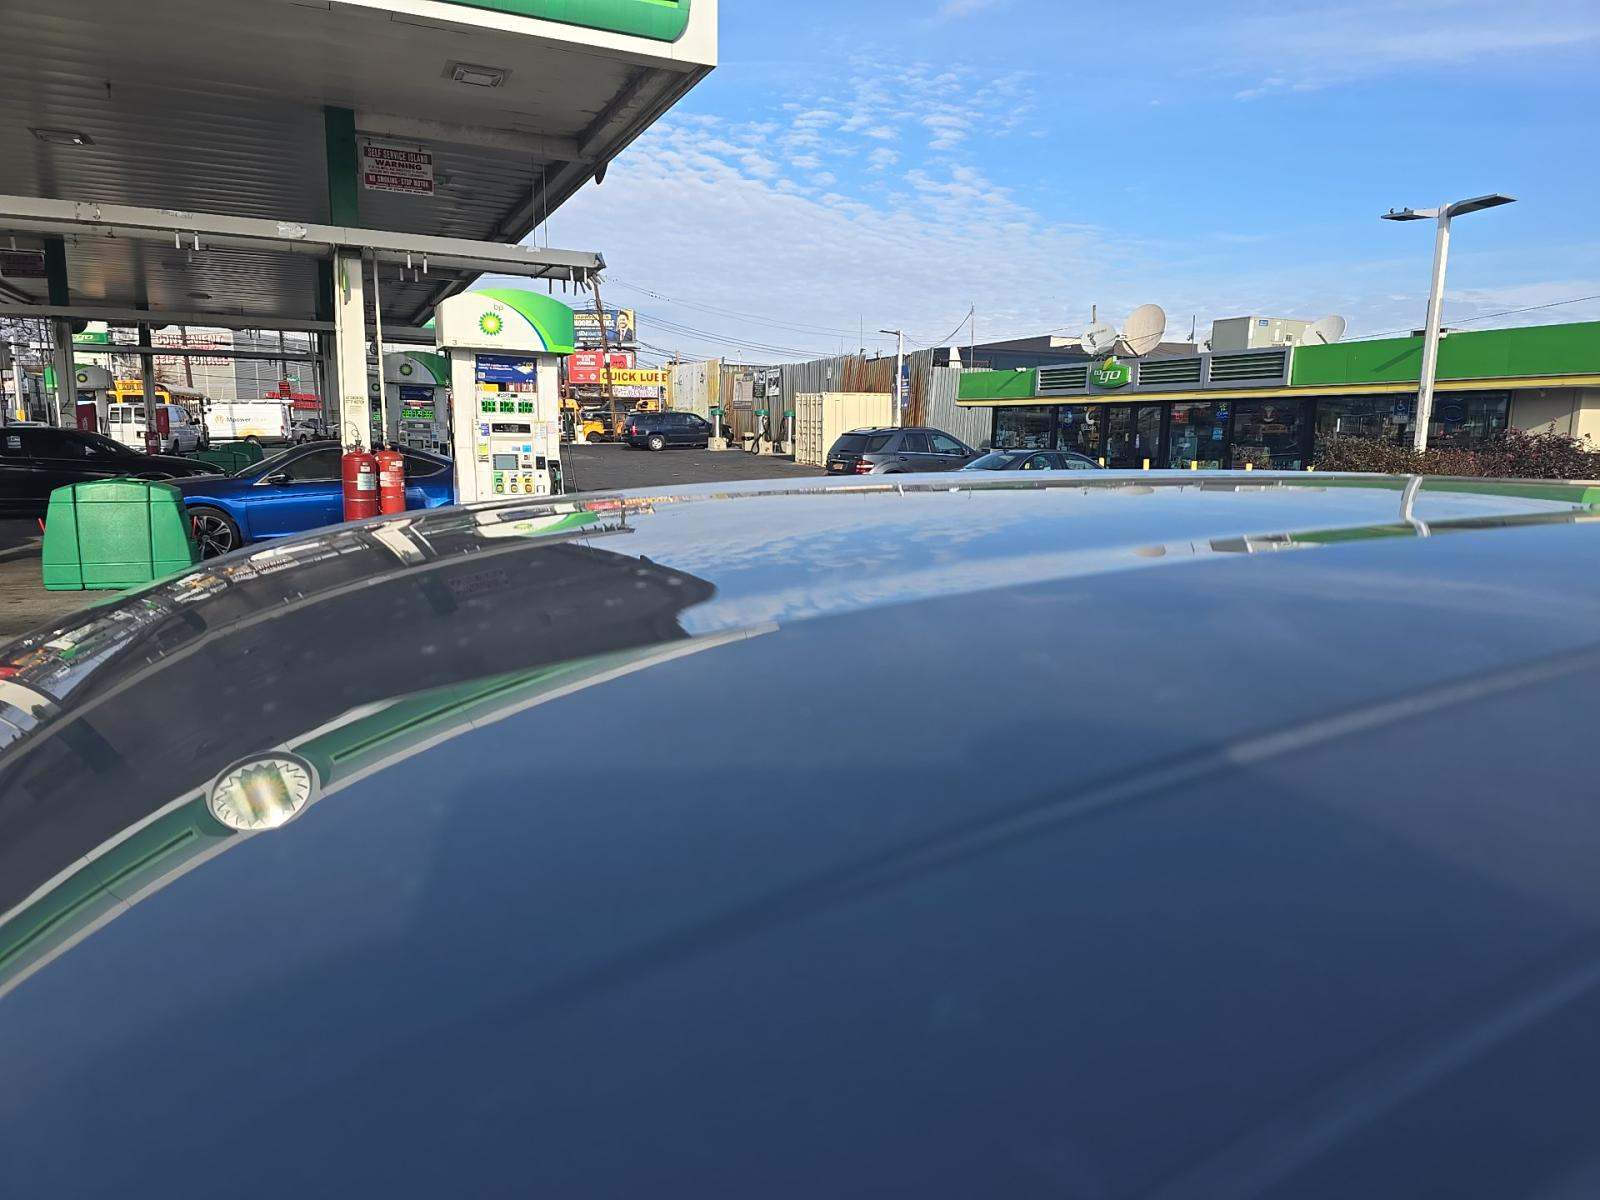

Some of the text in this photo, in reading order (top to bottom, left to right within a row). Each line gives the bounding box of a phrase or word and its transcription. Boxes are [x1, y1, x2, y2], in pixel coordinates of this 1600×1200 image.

[368, 147, 428, 164] SELF SERVICE ISLAND
[375, 159, 422, 171] WARNING
[493, 303, 504, 312] bp
